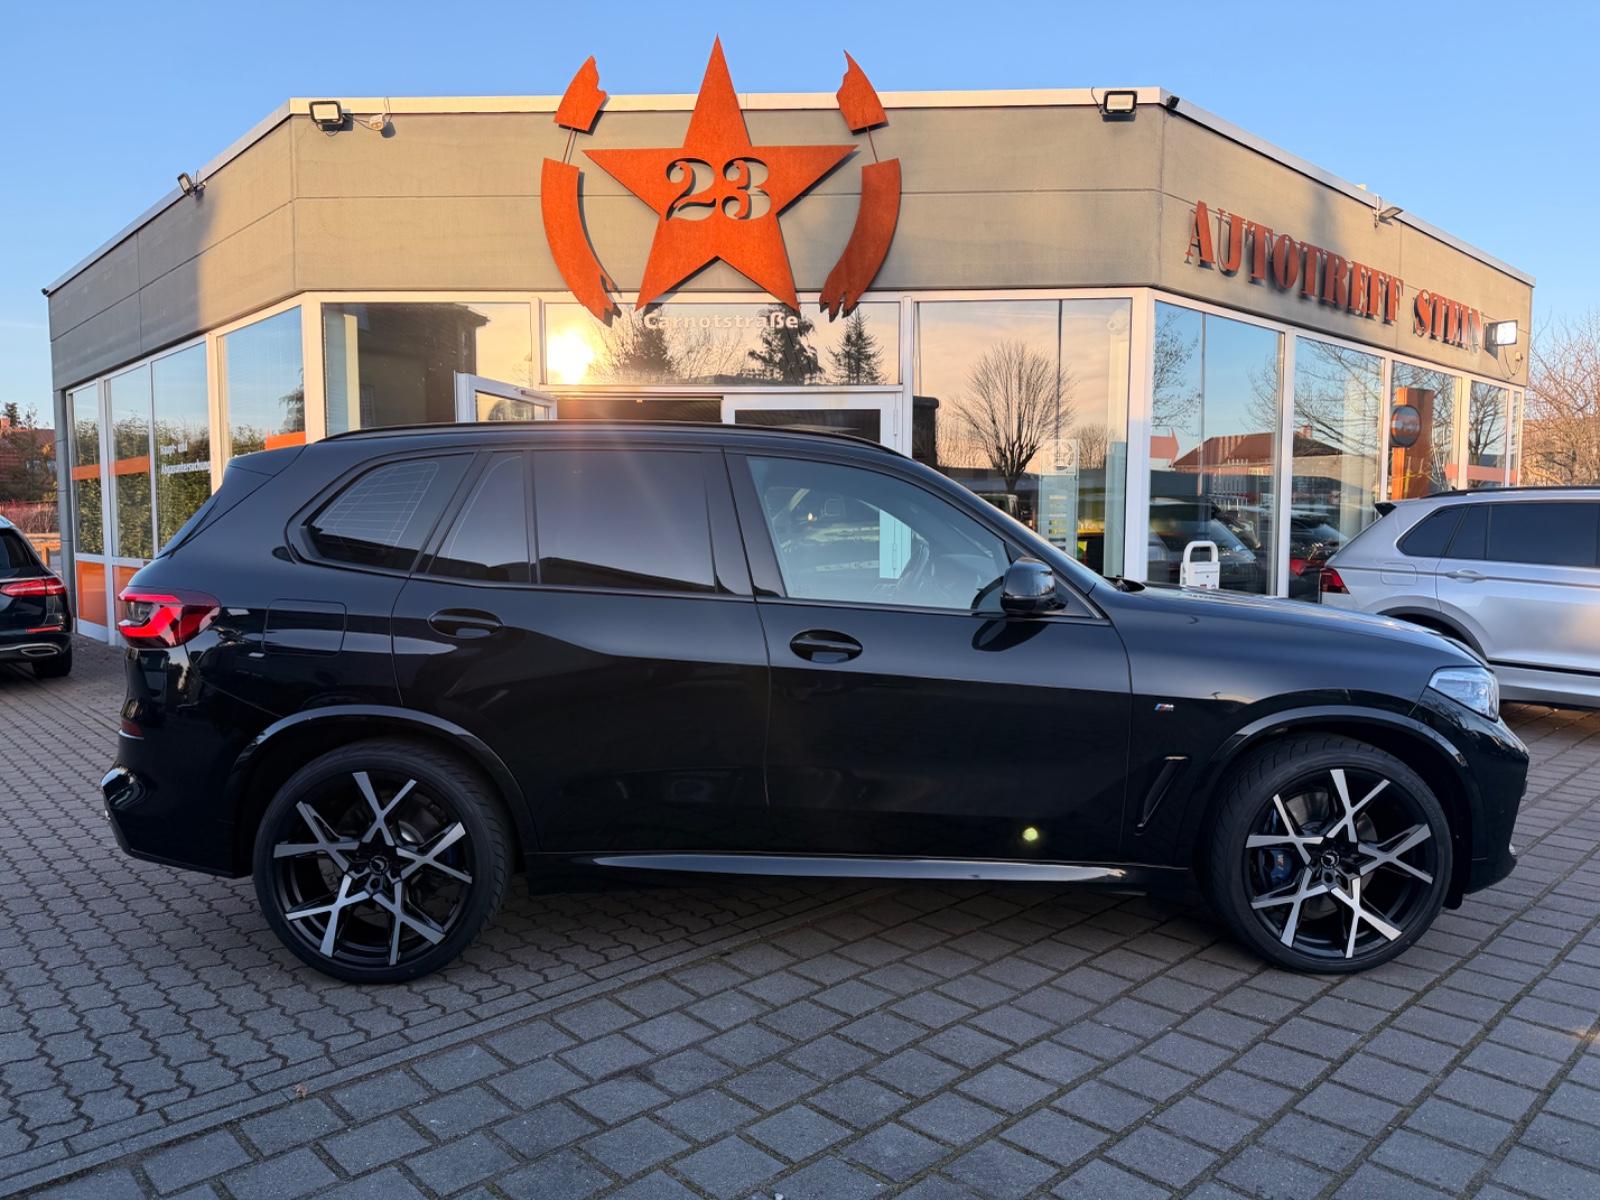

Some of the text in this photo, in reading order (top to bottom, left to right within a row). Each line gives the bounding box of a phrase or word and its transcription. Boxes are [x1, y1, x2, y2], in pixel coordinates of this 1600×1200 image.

[665, 156, 772, 221] 23
[1184, 200, 1404, 323] AUTOTREFF
[643, 311, 799, 329] Carnotstraße
